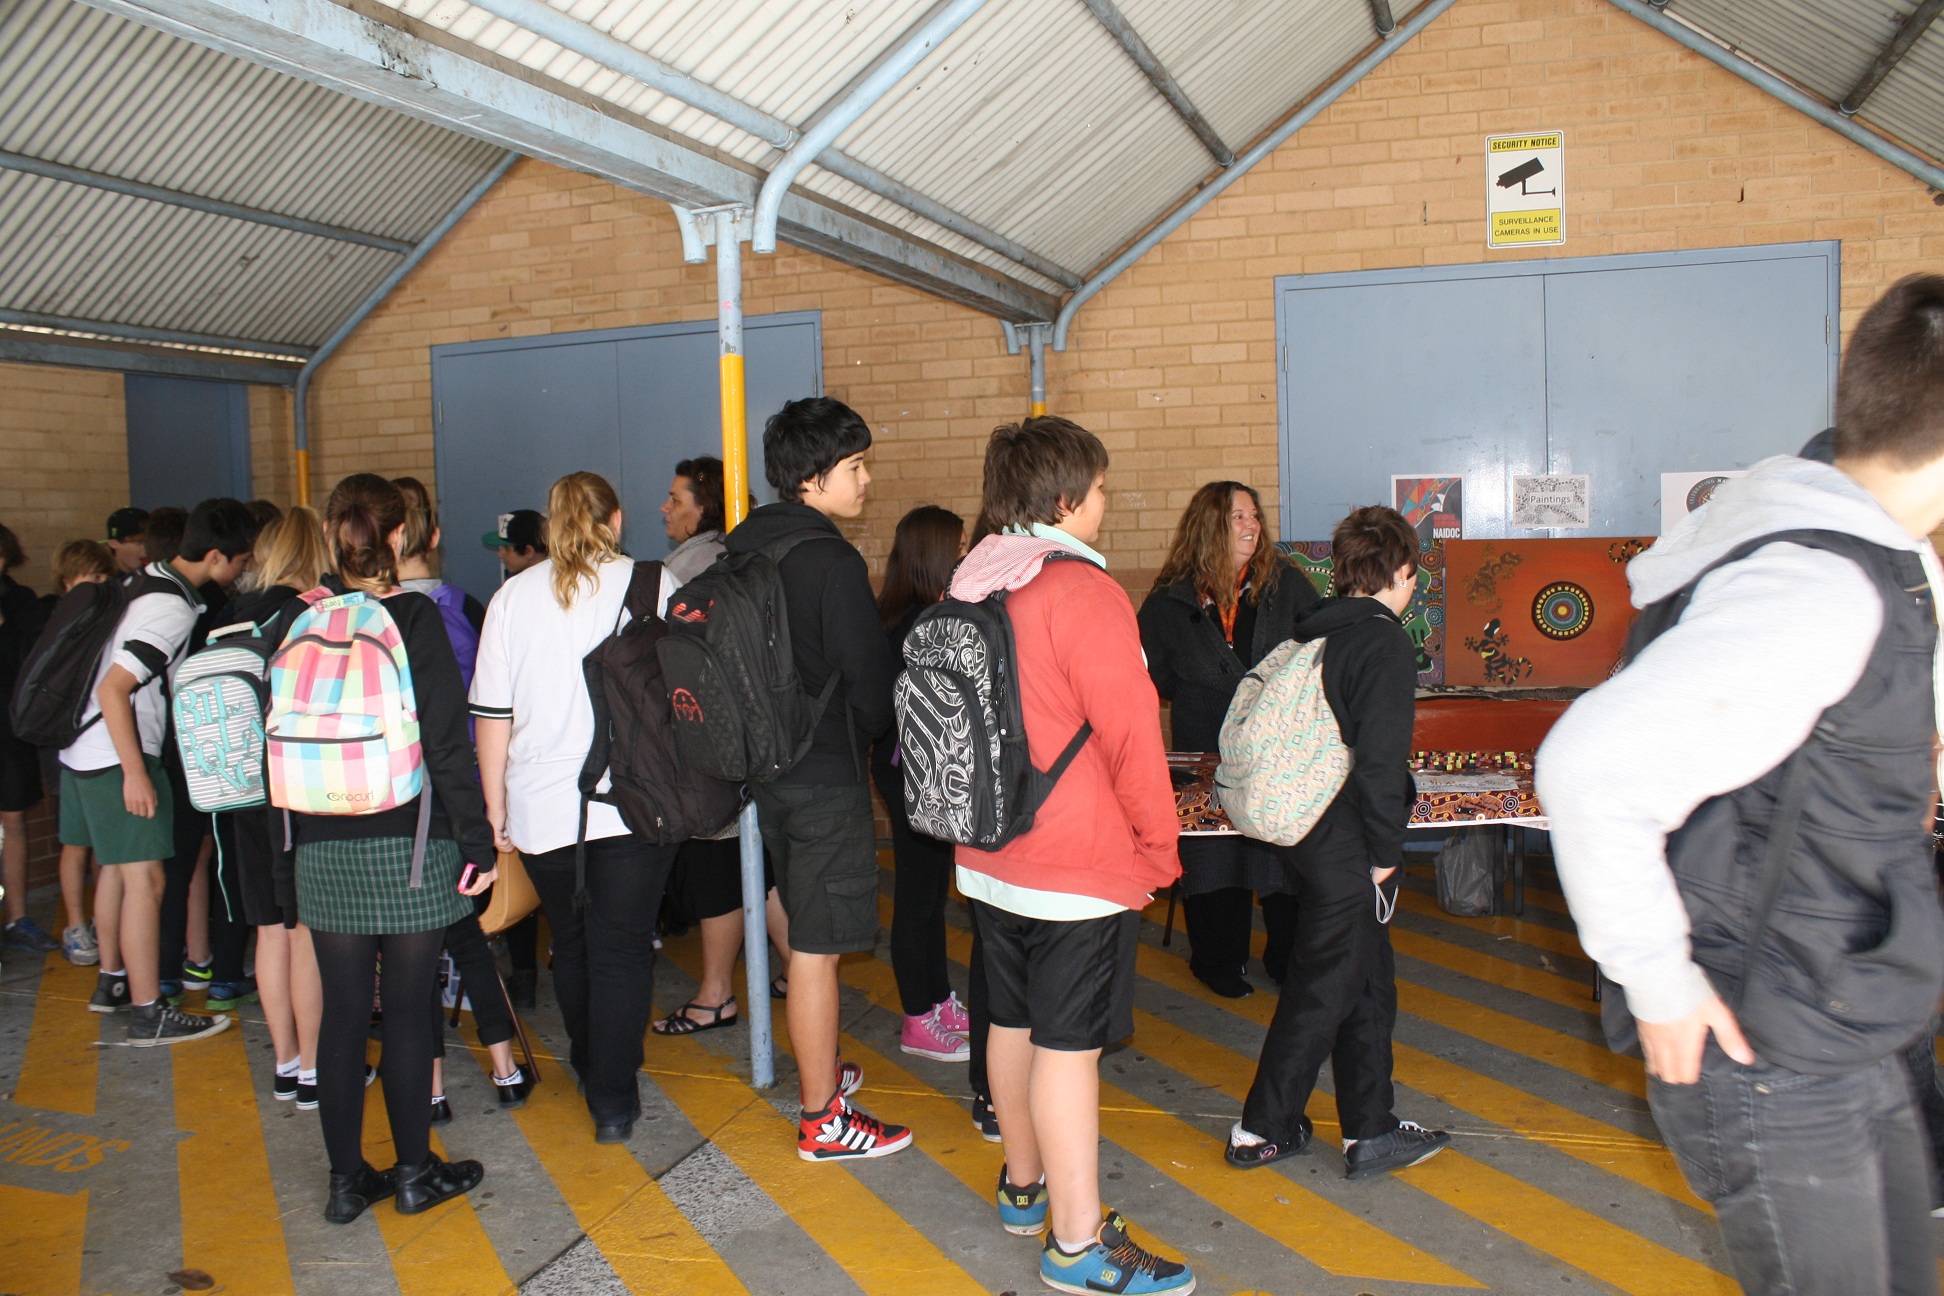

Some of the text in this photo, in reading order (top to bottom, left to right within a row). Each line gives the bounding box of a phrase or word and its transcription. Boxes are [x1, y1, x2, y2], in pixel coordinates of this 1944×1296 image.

[1492, 137, 1557, 150] SECURITY NOTICE
[1498, 216, 1554, 226] SURVEILLANCE
[1494, 228, 1531, 237] CAMERAS
[1543, 226, 1559, 234] USE
[1530, 495, 1571, 505] Paintings
[1433, 527, 1460, 539] NAIDOC
